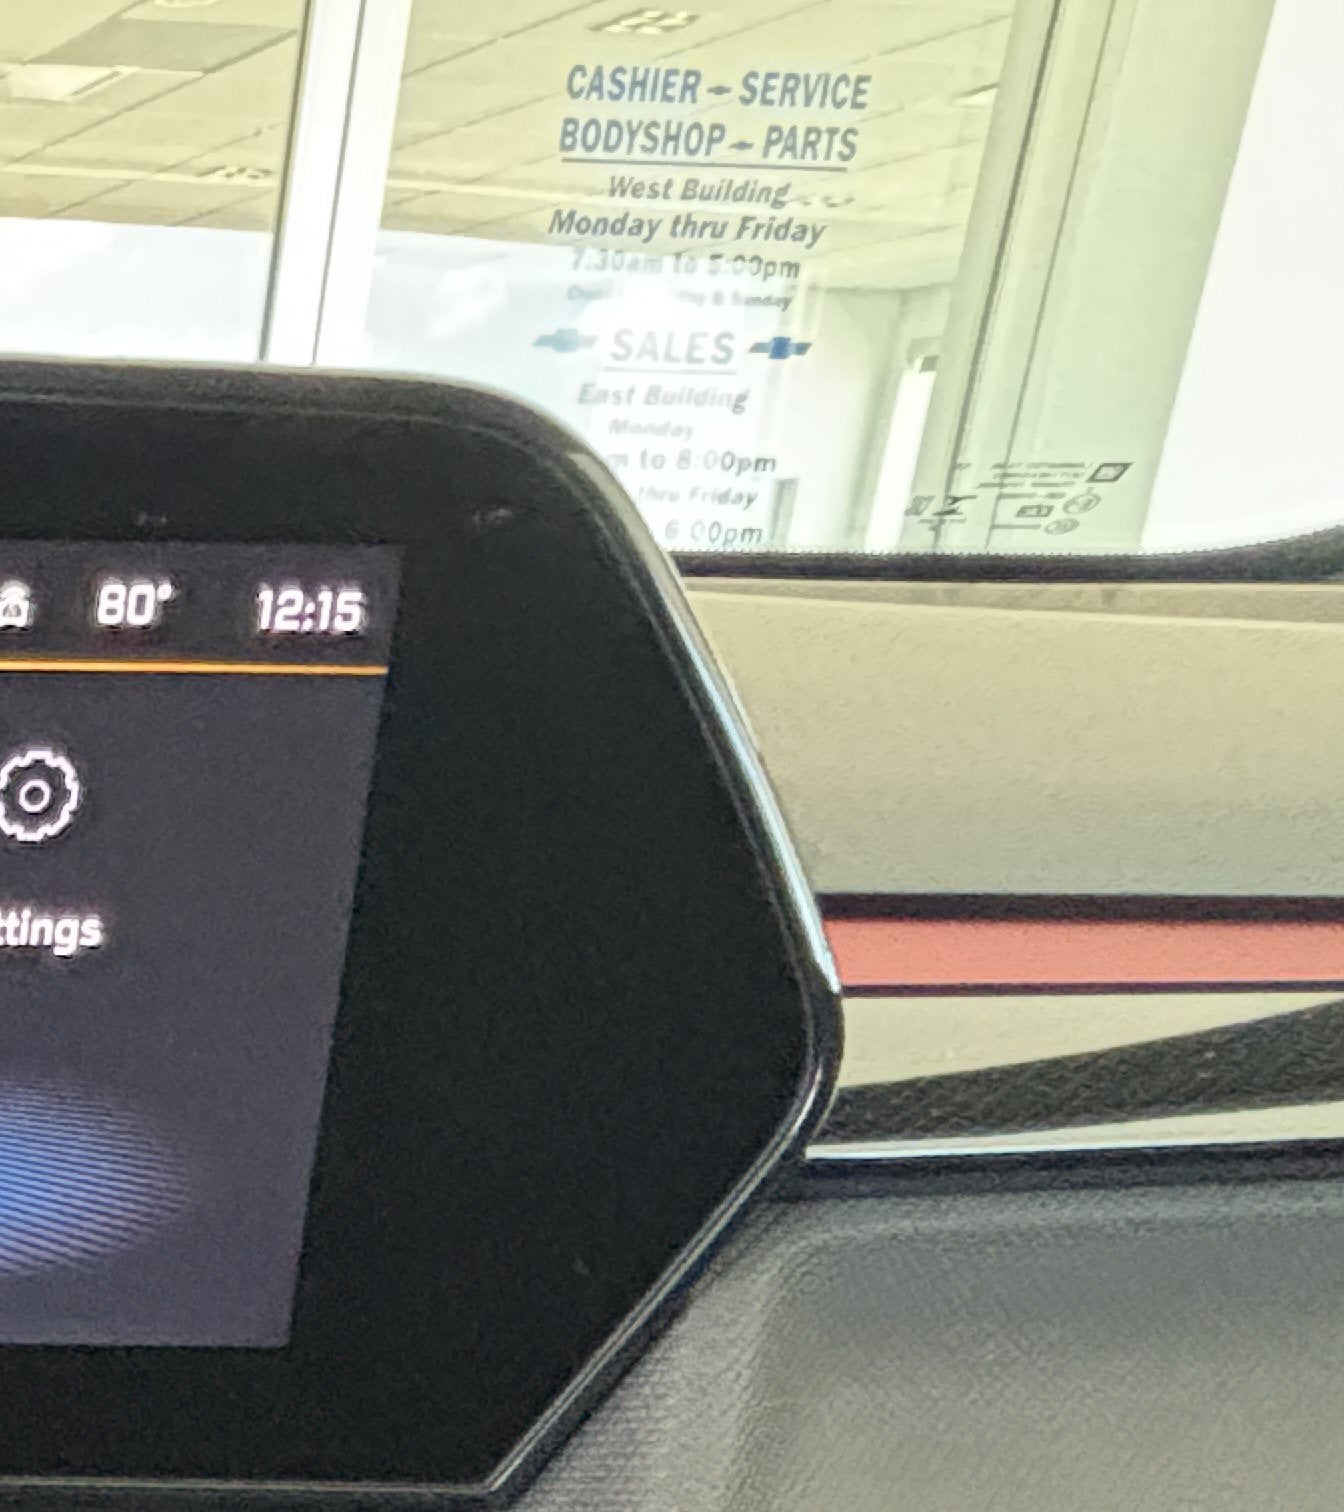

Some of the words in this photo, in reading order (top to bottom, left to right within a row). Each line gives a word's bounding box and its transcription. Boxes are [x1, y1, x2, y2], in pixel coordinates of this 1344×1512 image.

[566, 64, 702, 104] CASHIER
[739, 71, 872, 110] SERVICE
[560, 117, 726, 156] BODYSHOP
[762, 125, 859, 162] PARTS
[608, 176, 672, 200] West
[680, 178, 791, 209] Building
[548, 209, 663, 243] Monday
[670, 213, 729, 240] thru
[735, 216, 827, 249] Friday
[610, 328, 735, 364] SALES
[578, 382, 636, 405] East
[644, 384, 750, 415] Building
[257, 584, 364, 634] 12:15
